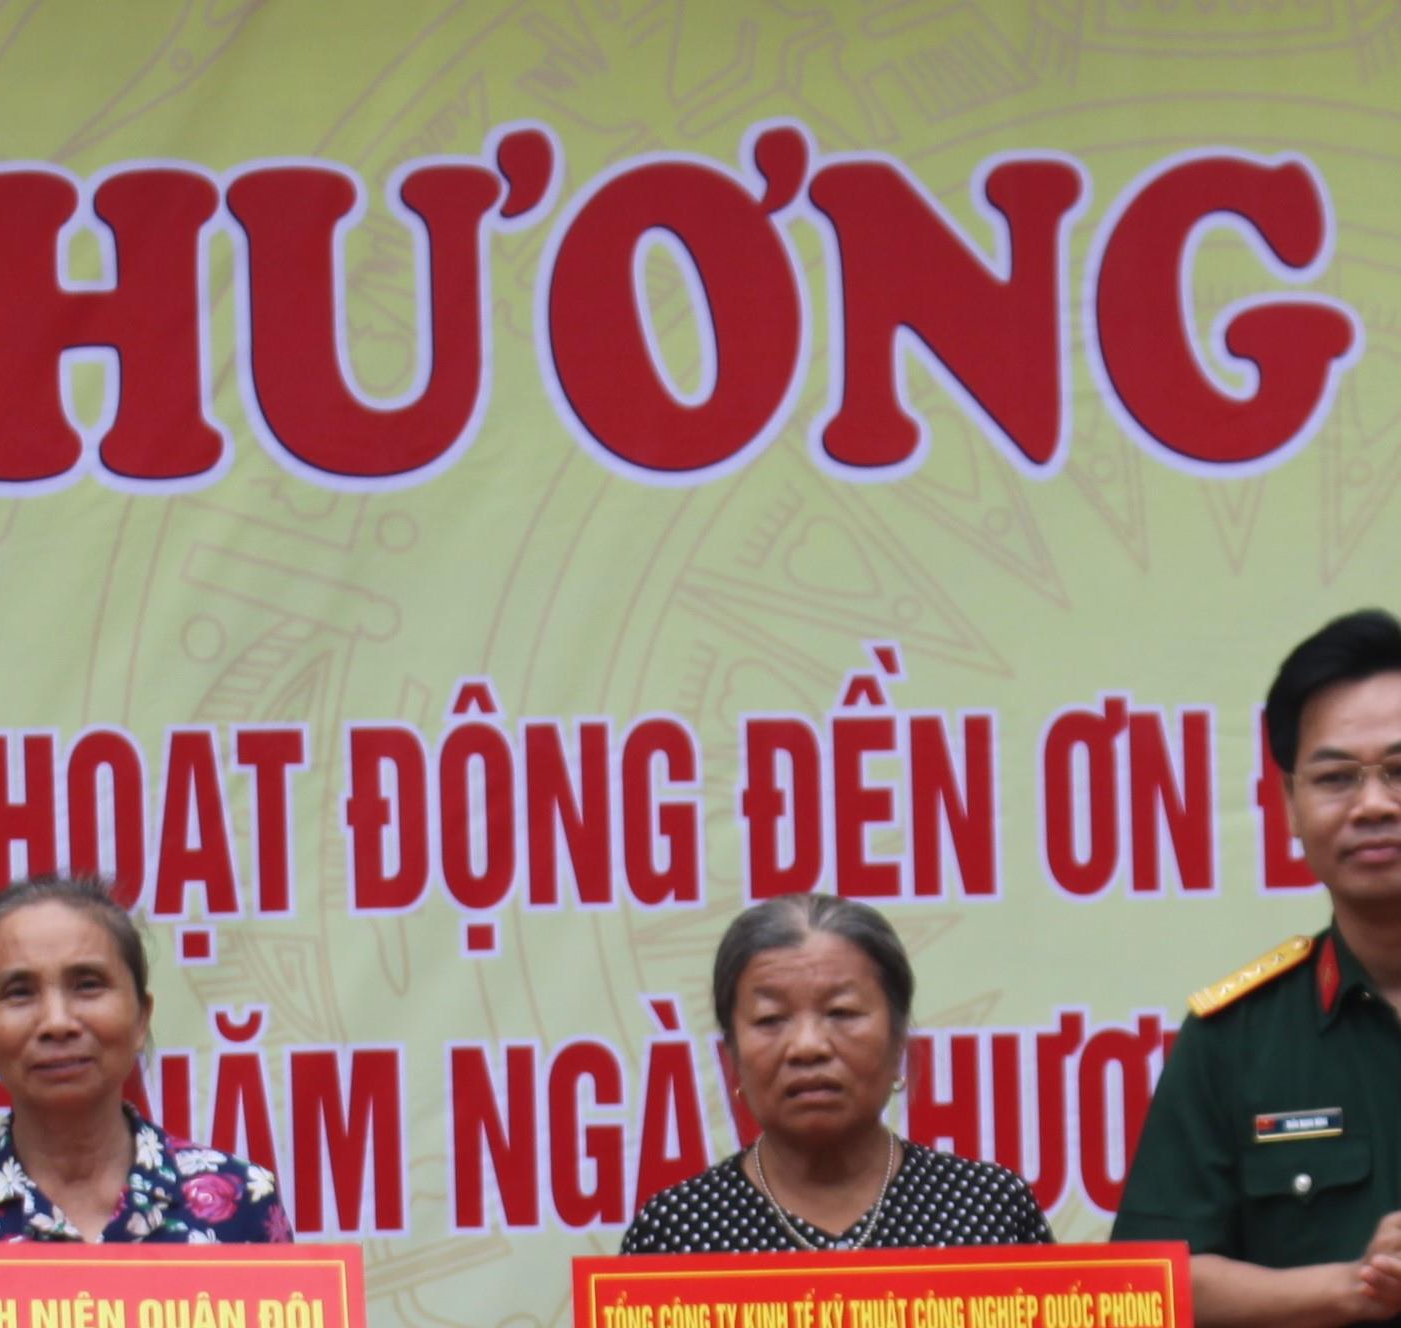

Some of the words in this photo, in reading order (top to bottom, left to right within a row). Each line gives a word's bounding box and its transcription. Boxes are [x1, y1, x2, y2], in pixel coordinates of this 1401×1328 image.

[344, 681, 701, 953] ĐỘNG
[740, 645, 998, 903] ĐỀN
[1042, 696, 1215, 898] ƠN
[1099, 1283, 1163, 1328] PHÒNG
